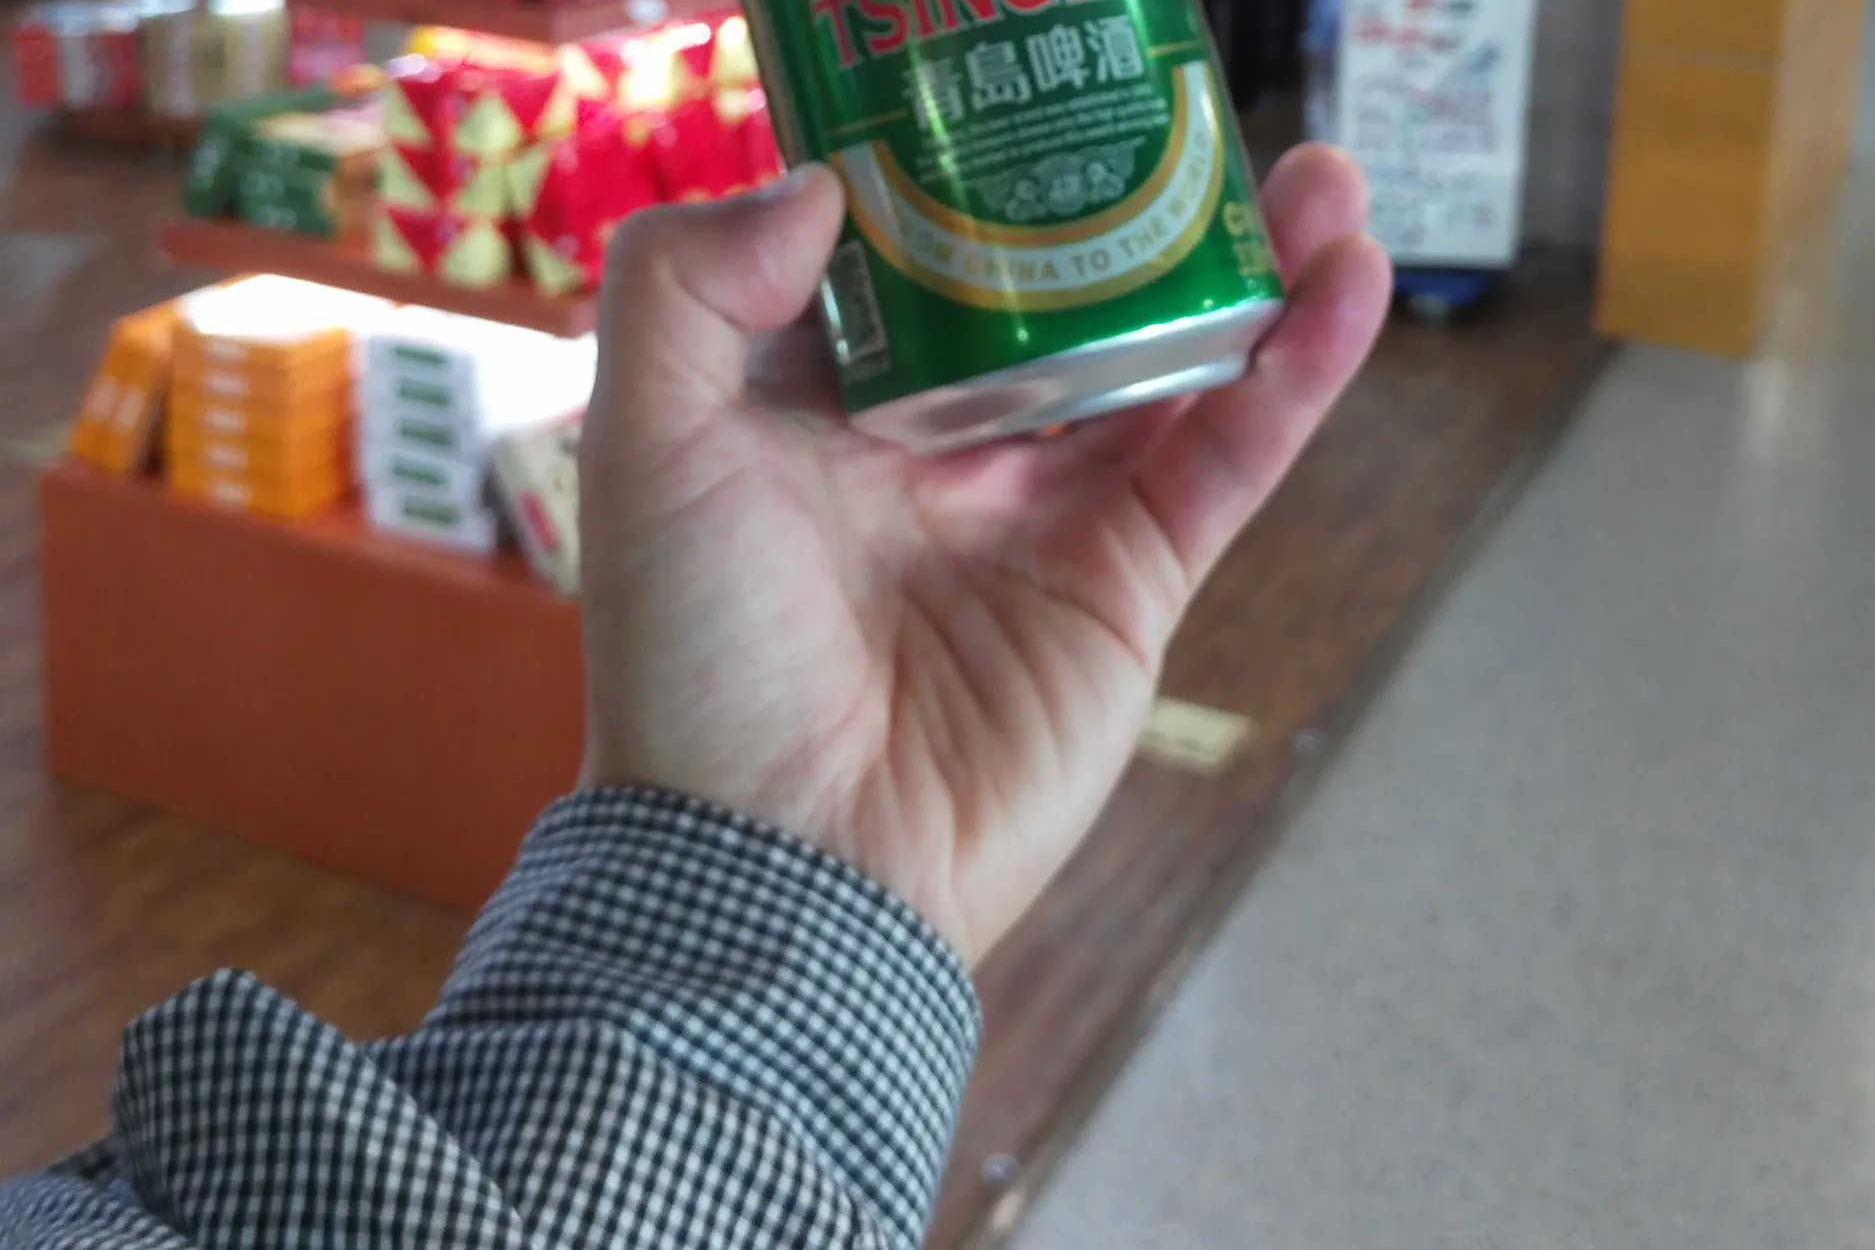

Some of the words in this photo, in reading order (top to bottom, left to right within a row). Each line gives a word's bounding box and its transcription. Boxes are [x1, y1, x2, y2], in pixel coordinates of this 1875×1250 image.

[901, 14, 1144, 131] 青島啤酒
[1070, 248, 1111, 278] TO
[1116, 216, 1170, 261] THE
